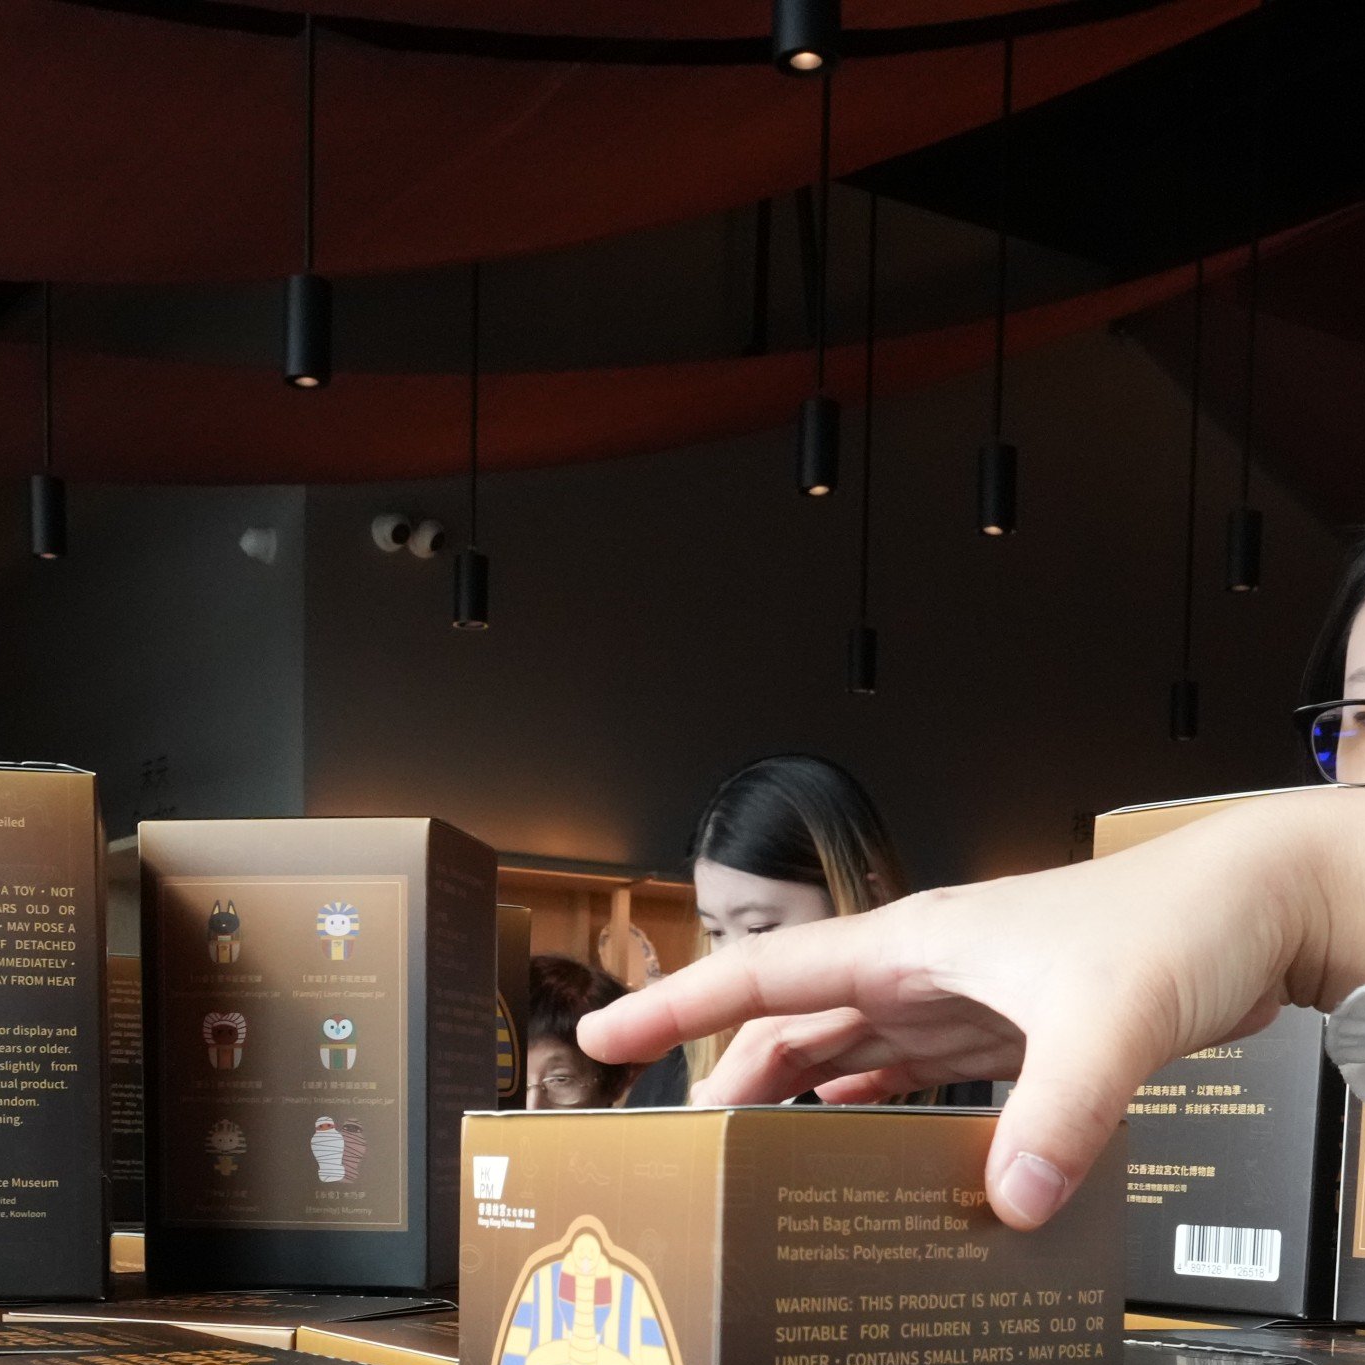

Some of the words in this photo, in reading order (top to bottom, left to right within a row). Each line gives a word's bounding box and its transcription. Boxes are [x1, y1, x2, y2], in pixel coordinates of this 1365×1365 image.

[1, 885, 9, 895] A
[13, 885, 36, 896] TOY
[51, 887, 75, 897] NOT
[25, 904, 50, 915] OLD
[58, 905, 76, 915] OR
[7, 921, 30, 932] MAY
[34, 922, 65, 933] POSE
[67, 923, 76, 933] A
[15, 939, 76, 951] DETACHED
[11, 975, 44, 986] FROM
[47, 976, 76, 986] HEAT
[11, 1178, 59, 1188] Museum
[778, 1187, 837, 1203] Product
[843, 1187, 889, 1203] Name:
[894, 1187, 947, 1203] Ancient
[952, 1187, 992, 1205] Egyp
[777, 1215, 819, 1232] Plush
[822, 1215, 851, 1236] Bag
[853, 1215, 902, 1232] Charm
[904, 1215, 941, 1231] Blind
[943, 1215, 969, 1232] Box
[777, 1243, 849, 1261] Materials:
[853, 1244, 922, 1264] Polyester,
[925, 1243, 954, 1260] Zinc
[956, 1242, 989, 1262] alloy
[1190, 1263, 1222, 1276] 897126
[1232, 1266, 1265, 1279] 126518
